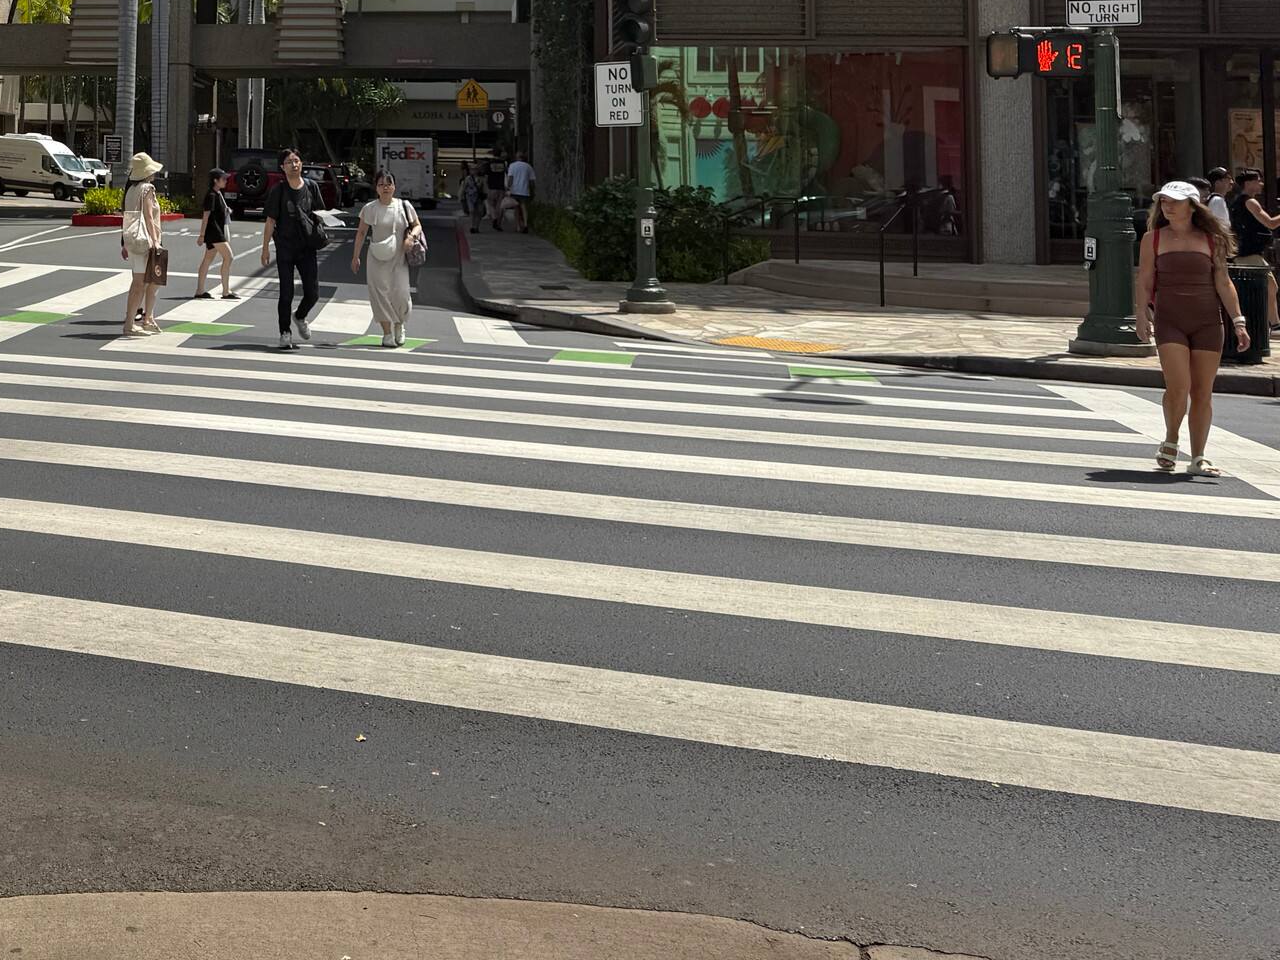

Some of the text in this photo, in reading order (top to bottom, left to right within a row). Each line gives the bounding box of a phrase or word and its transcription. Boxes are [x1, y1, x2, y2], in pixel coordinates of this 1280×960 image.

[1070, 2, 1136, 14] NO RIGHT
[1088, 14, 1119, 23] TURN
[1066, 44, 1082, 69] 12
[608, 67, 628, 80] NO
[605, 84, 632, 94] TURN
[611, 97, 626, 107] ON
[412, 112, 444, 120] ALOHA
[609, 110, 629, 120] RED
[382, 146, 426, 160] FedEx
